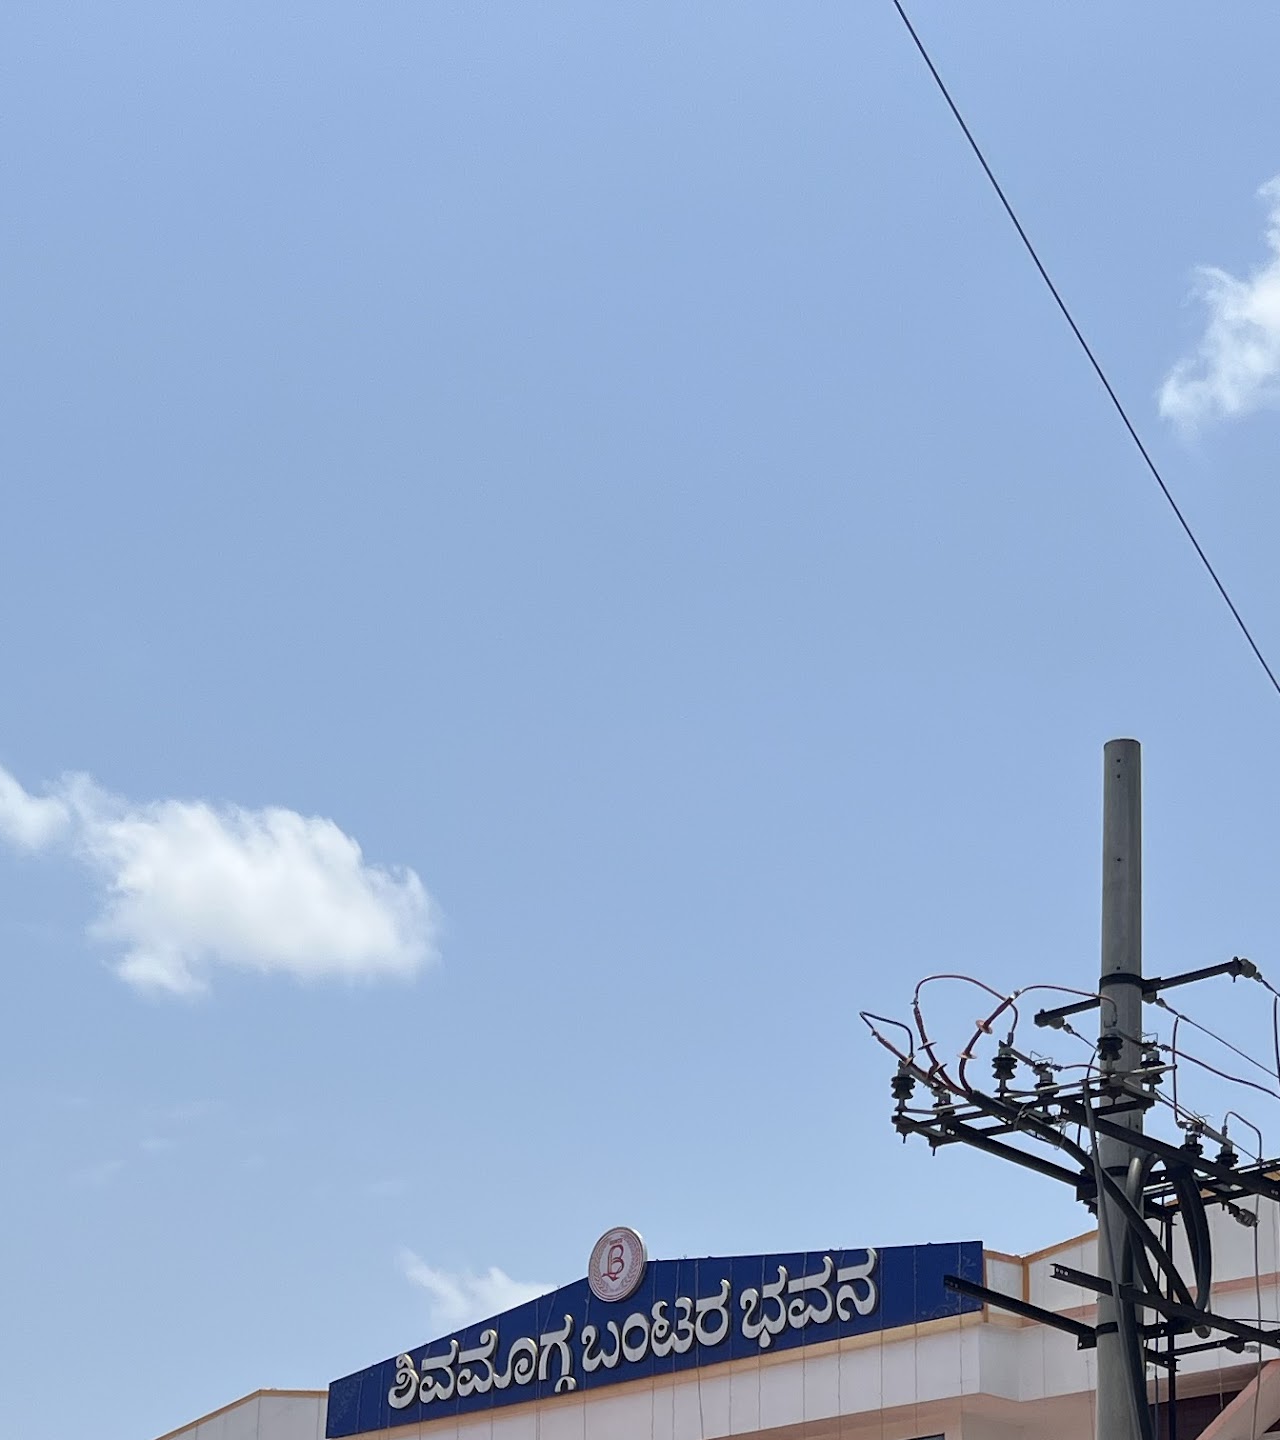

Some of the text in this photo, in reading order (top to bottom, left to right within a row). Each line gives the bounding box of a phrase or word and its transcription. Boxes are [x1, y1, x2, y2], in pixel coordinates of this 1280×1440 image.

[387, 1248, 879, 1410] ಶಿವಮೊಗ್ಗ ಬಂಟರ ಭವನ
